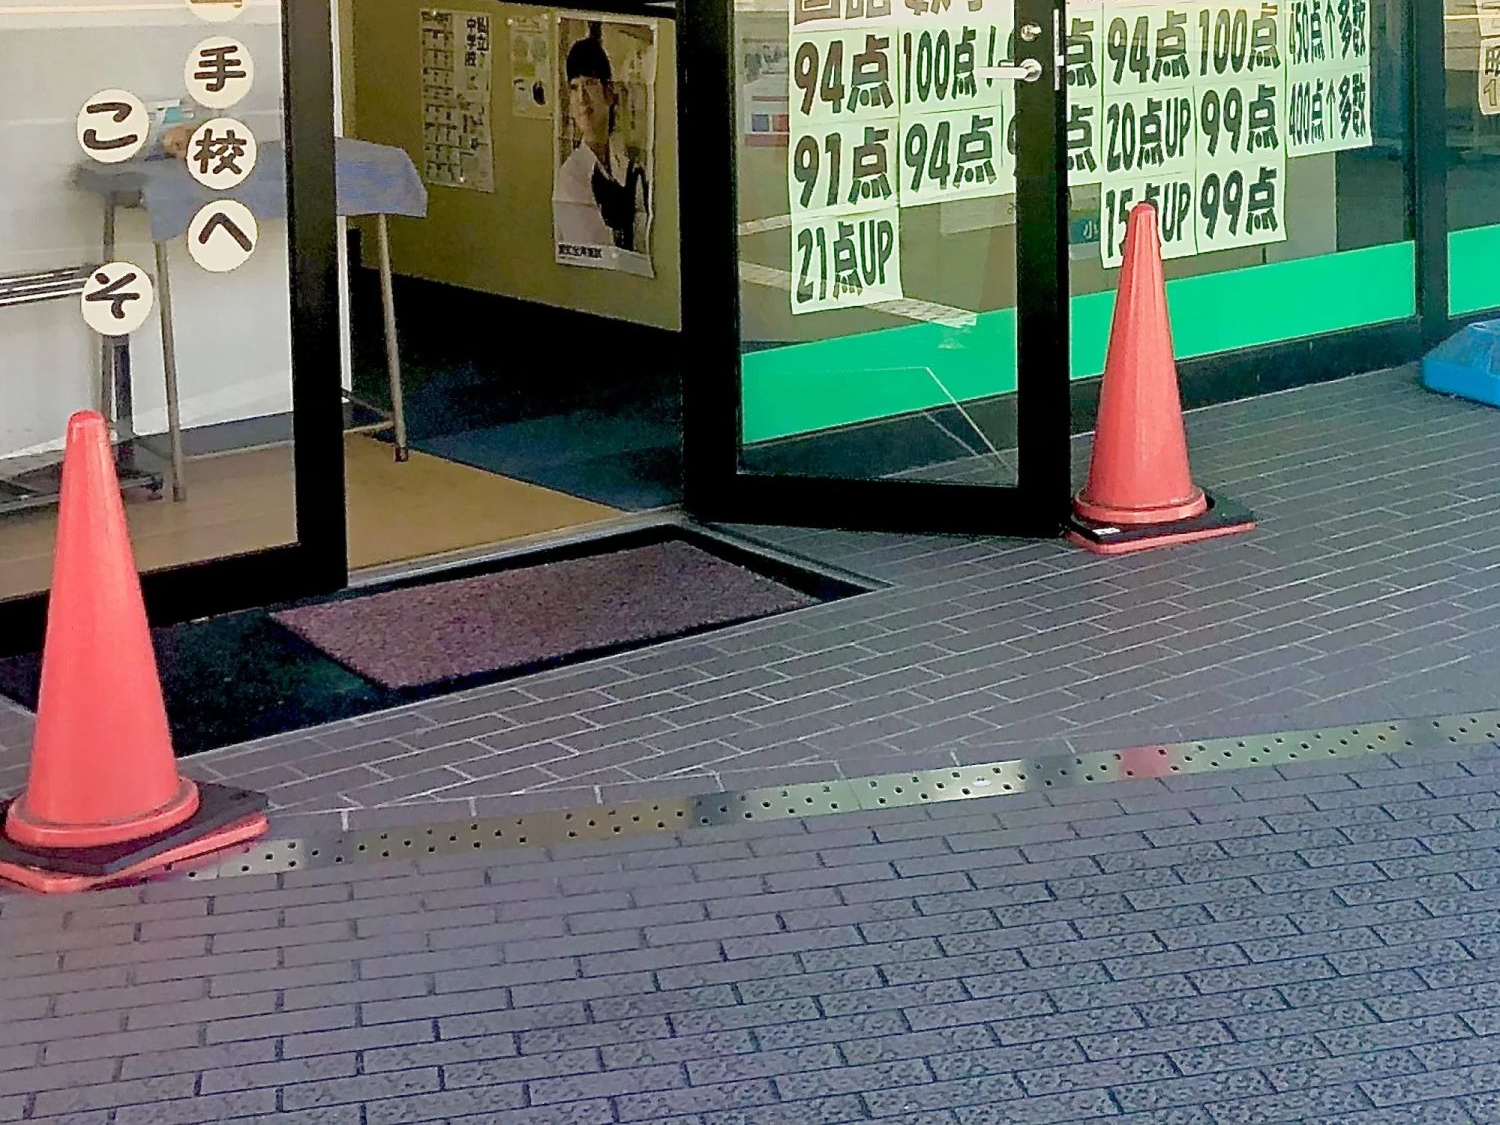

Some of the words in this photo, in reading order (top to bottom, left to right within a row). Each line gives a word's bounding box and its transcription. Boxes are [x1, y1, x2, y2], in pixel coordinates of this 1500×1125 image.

[794, 34, 894, 115] 94点
[1107, 11, 1190, 86] 94点
[1199, 3, 1281, 77] 100点
[794, 127, 892, 209] 91点
[905, 115, 998, 193] 94点
[1107, 97, 1191, 173] 20点UP
[1201, 84, 1280, 157] 99点
[797, 220, 894, 305] 21点UP
[1200, 166, 1281, 241] 99点
